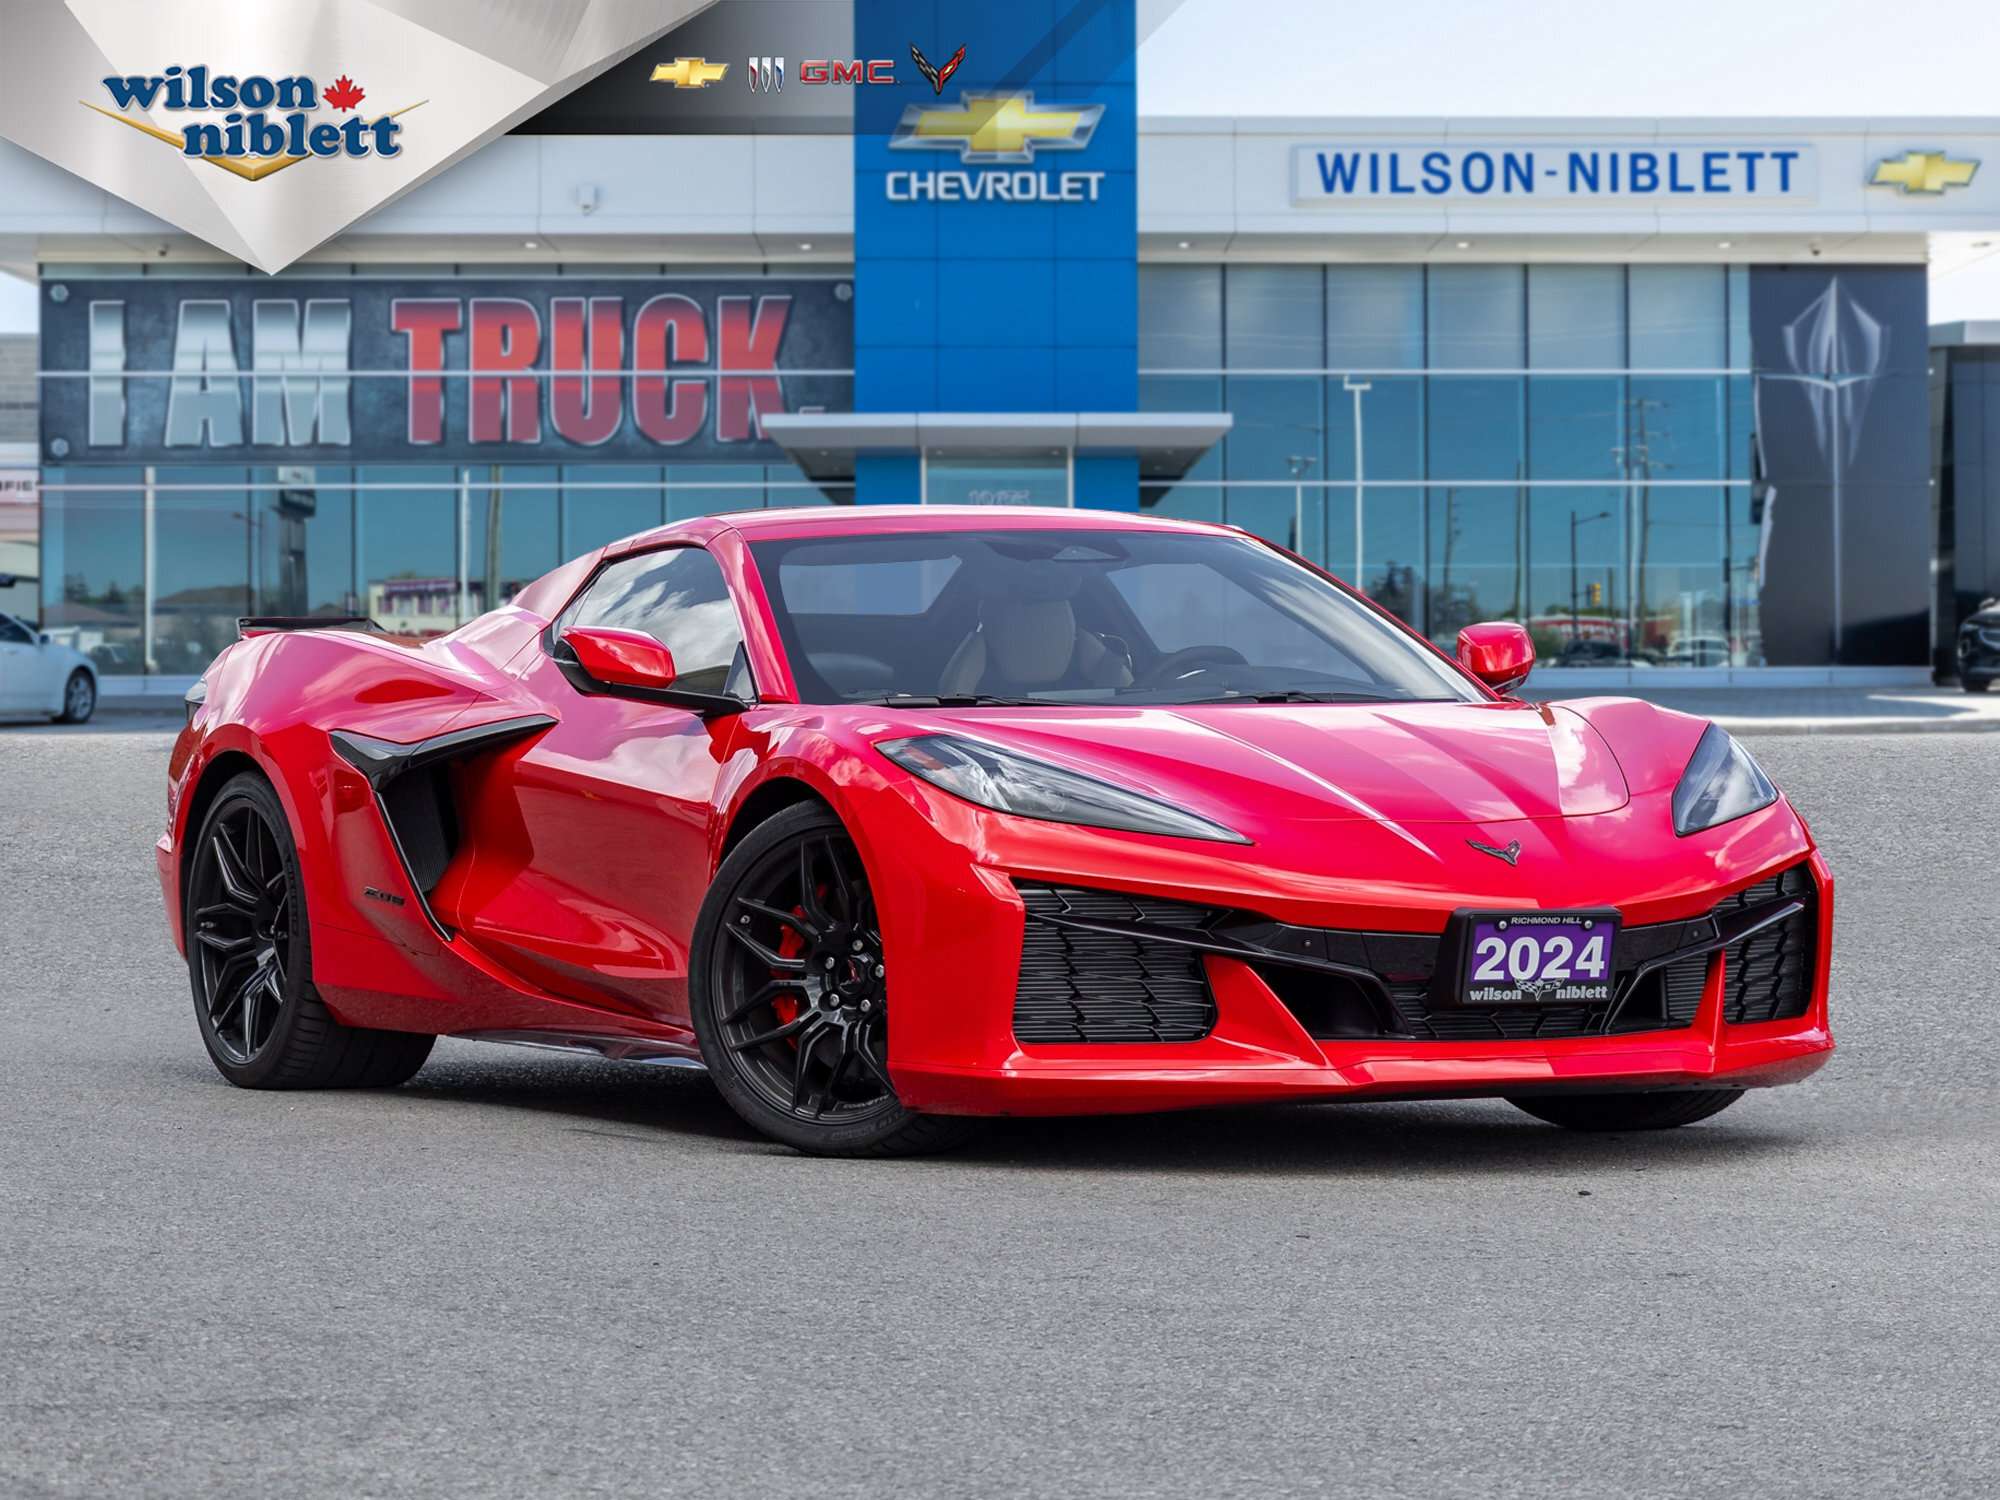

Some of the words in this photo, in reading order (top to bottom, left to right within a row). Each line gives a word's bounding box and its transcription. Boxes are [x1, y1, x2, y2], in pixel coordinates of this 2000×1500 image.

[886, 172, 1105, 201] CHEVROLET
[1316, 151, 1799, 195] WILSON-NIBLETT
[88, 300, 126, 447] I
[164, 299, 352, 447] AM
[391, 294, 793, 445] TRUCK
[1511, 916, 1561, 925] RICHMOND
[1562, 916, 1582, 925] HILL
[1474, 936, 1605, 980] 2024
[1470, 987, 1522, 1000] wilson
[1555, 986, 1608, 999] niblett
